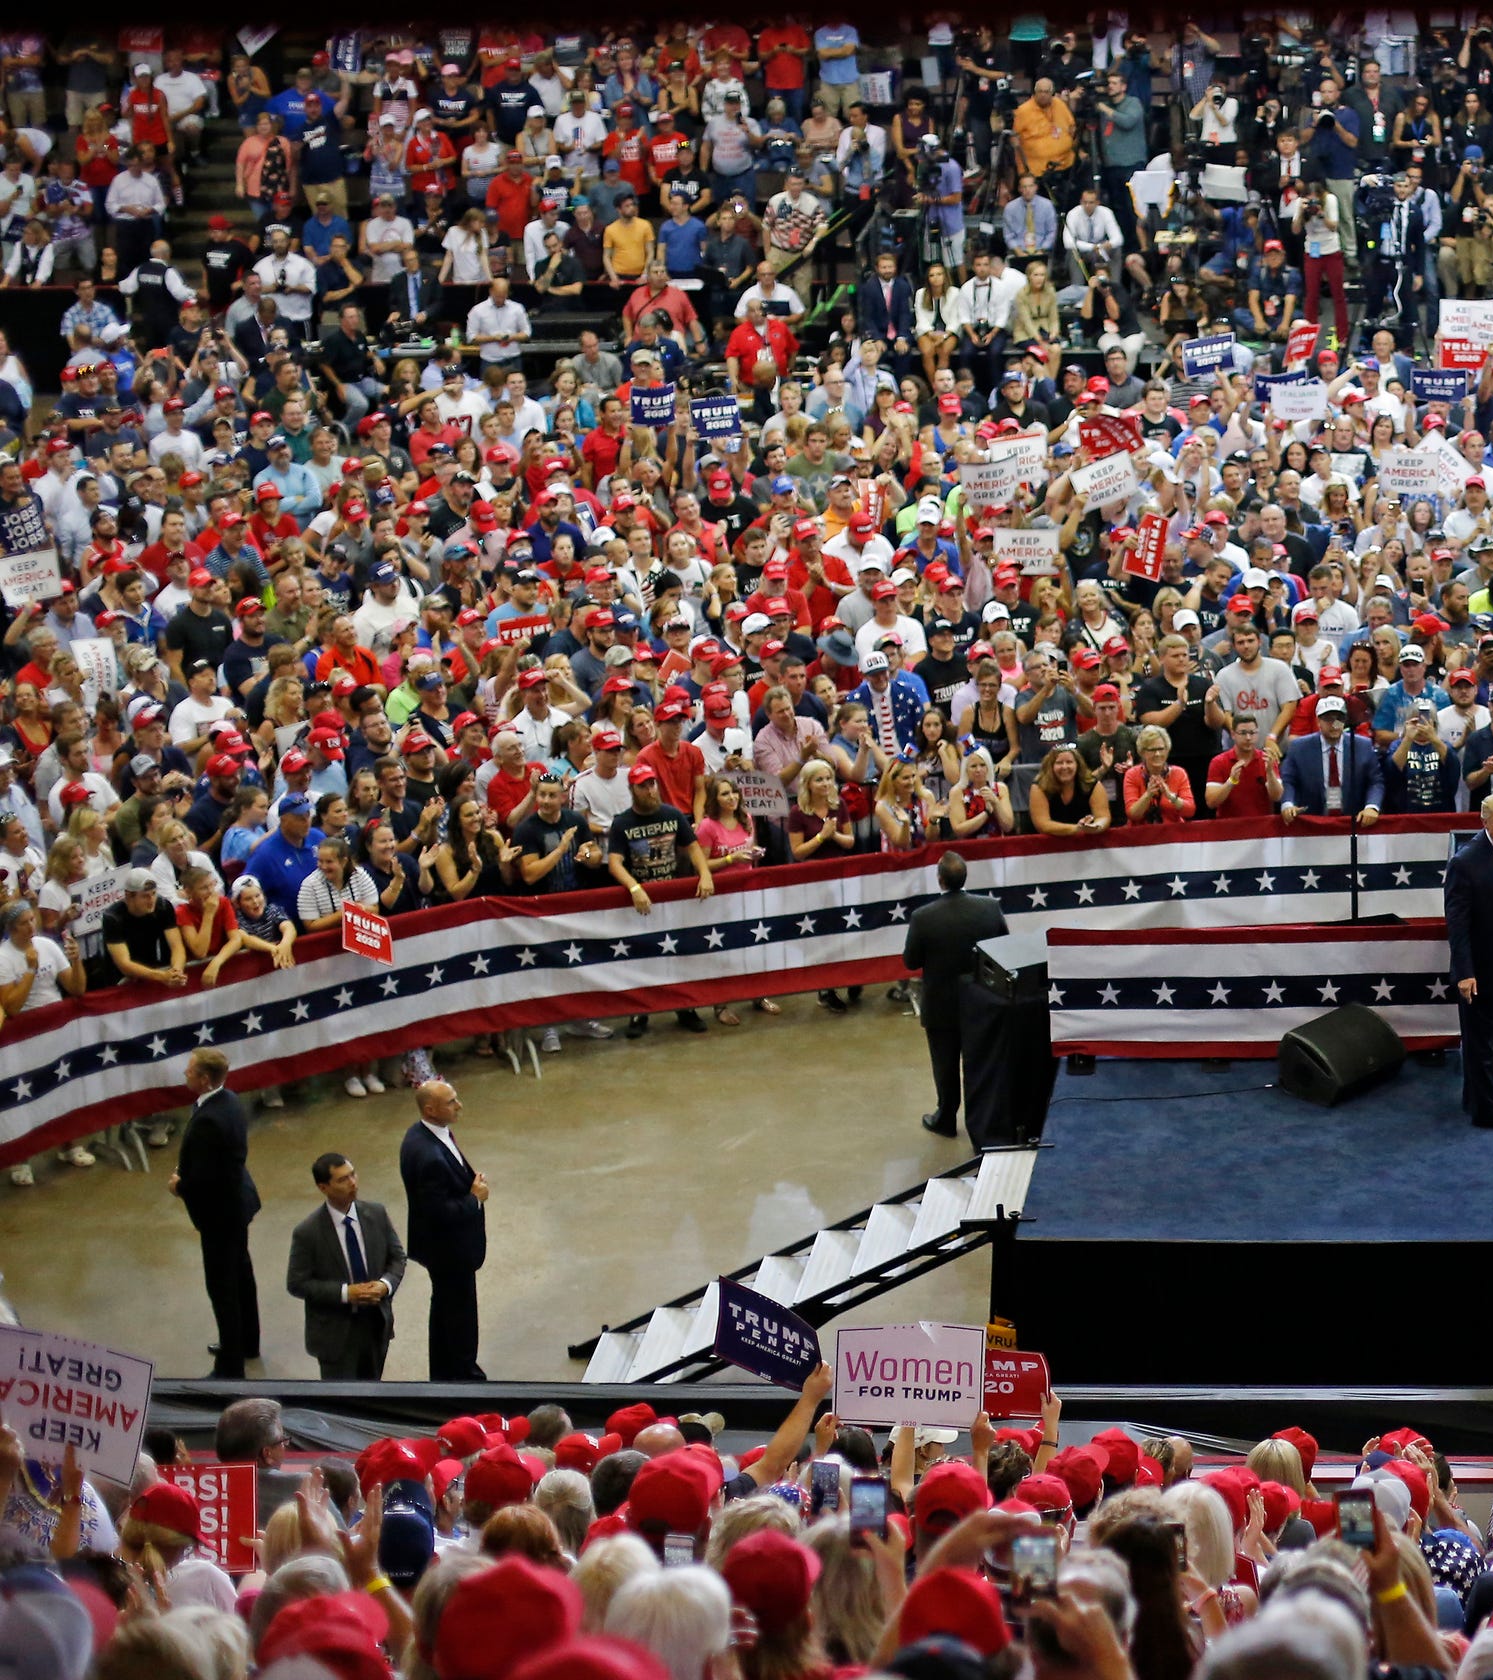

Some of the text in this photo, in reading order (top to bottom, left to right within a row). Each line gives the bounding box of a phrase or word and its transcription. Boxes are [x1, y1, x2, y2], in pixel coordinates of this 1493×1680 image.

[1185, 341, 1233, 357] TRUMP
[1453, 354, 1481, 363] 2020
[1413, 377, 1465, 387] TRUMP
[632, 393, 676, 408] TRUMP
[1280, 390, 1318, 399] ITALIANS
[1425, 389, 1454, 398] 2020
[643, 409, 671, 420] 2020
[692, 403, 739, 419] TRUMP
[1285, 407, 1315, 415] TRUMP
[705, 418, 733, 431] 2020
[1006, 445, 1031, 458] KEEP
[1017, 457, 1044, 470] RICA
[1397, 459, 1424, 468] KEEP
[977, 468, 1004, 481] KEEP
[1089, 466, 1114, 483] KEEP
[1383, 468, 1436, 479] AMERICA
[1087, 471, 1131, 494] MERICA
[1390, 479, 1429, 490] GREAT!
[973, 487, 1009, 501] GREAT!
[1090, 483, 1126, 503] GREAT!
[1, 503, 41, 528] JOBS!
[6, 517, 44, 539] JOBS!
[10, 532, 47, 552] JOBS!
[1011, 536, 1041, 547] KEEP
[1145, 518, 1161, 576] TRUMP
[998, 546, 1054, 558] AMERICA
[10, 560, 38, 572] KEEP
[1020, 558, 1047, 568] EAT!
[2, 570, 55, 586] AMERICA
[866, 656, 885, 668] USA
[1236, 689, 1269, 711] Ohio
[1040, 727, 1066, 741] 2020
[736, 775, 767, 787] KEEP
[741, 786, 784, 800] ERICA
[743, 799, 777, 810] REAT!
[625, 819, 679, 843] VETERAN
[88, 879, 116, 894] KEEP
[83, 890, 127, 911] MERIC
[345, 911, 389, 936] TRUMP
[355, 932, 382, 950] 2020
[728, 1302, 815, 1351] TRUMP
[736, 1322, 810, 1361] PENCE
[740, 1336, 802, 1366] KEEP AMERICA GREAT!
[18, 1345, 122, 1392] GREAT!
[845, 1350, 974, 1388] Women
[859, 1386, 963, 1402] FOR TRUMP
[984, 1381, 1014, 1394] 20
[900, 1419, 917, 1427] 2020
[29, 1416, 101, 1453] KEEP
[176, 1474, 228, 1501] BS!
